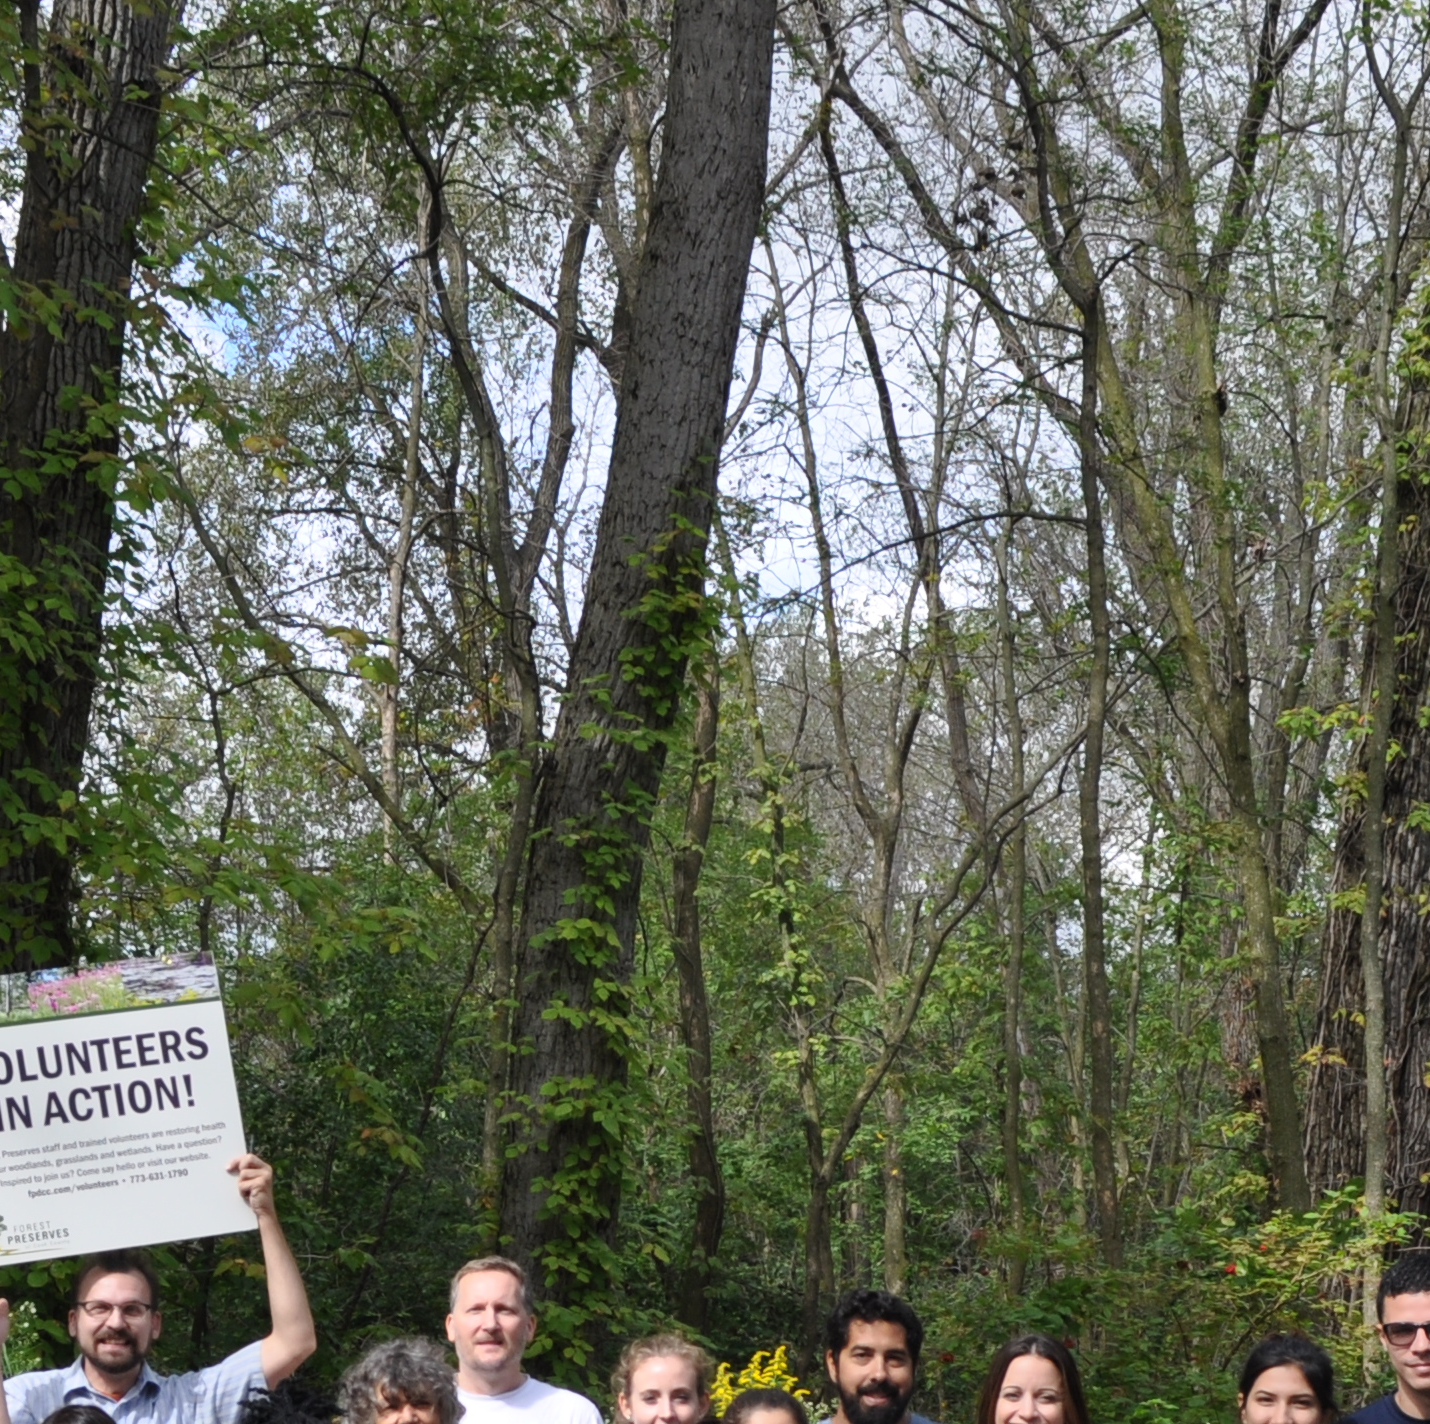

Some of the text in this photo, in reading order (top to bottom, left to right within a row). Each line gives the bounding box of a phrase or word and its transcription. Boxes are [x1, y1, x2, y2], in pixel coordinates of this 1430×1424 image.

[44, 1074, 195, 1126] ACTION!
[2, 1148, 40, 1158] Preserves
[42, 1143, 60, 1154] staff
[62, 1141, 77, 1150] and
[79, 1137, 107, 1148] trained
[108, 1132, 150, 1144] volunteers
[151, 1130, 164, 1138] are
[165, 1125, 200, 1136] restoring
[201, 1121, 226, 1131] health
[8, 1159, 54, 1172] woodlands,
[55, 1152, 99, 1167] grasslands
[100, 1150, 115, 1160] and
[116, 1146, 154, 1158] wetlands.
[156, 1142, 175, 1151] Have
[184, 1135, 222, 1149] question?
[0, 1176, 32, 1187] Inspired
[33, 1175, 42, 1183] to
[44, 1172, 59, 1182] join
[60, 1169, 74, 1180] us?
[76, 1167, 100, 1177] Come
[101, 1165, 114, 1174] say
[116, 1161, 136, 1171] hello
[147, 1157, 163, 1167] visit
[164, 1157, 177, 1165] our
[179, 1152, 211, 1163] website.
[28, 1168, 189, 1199] fpdcc.com/volunteers 773-631-1790
[7, 1228, 69, 1245] PRESERVES
[13, 1221, 51, 1233] FOREST
